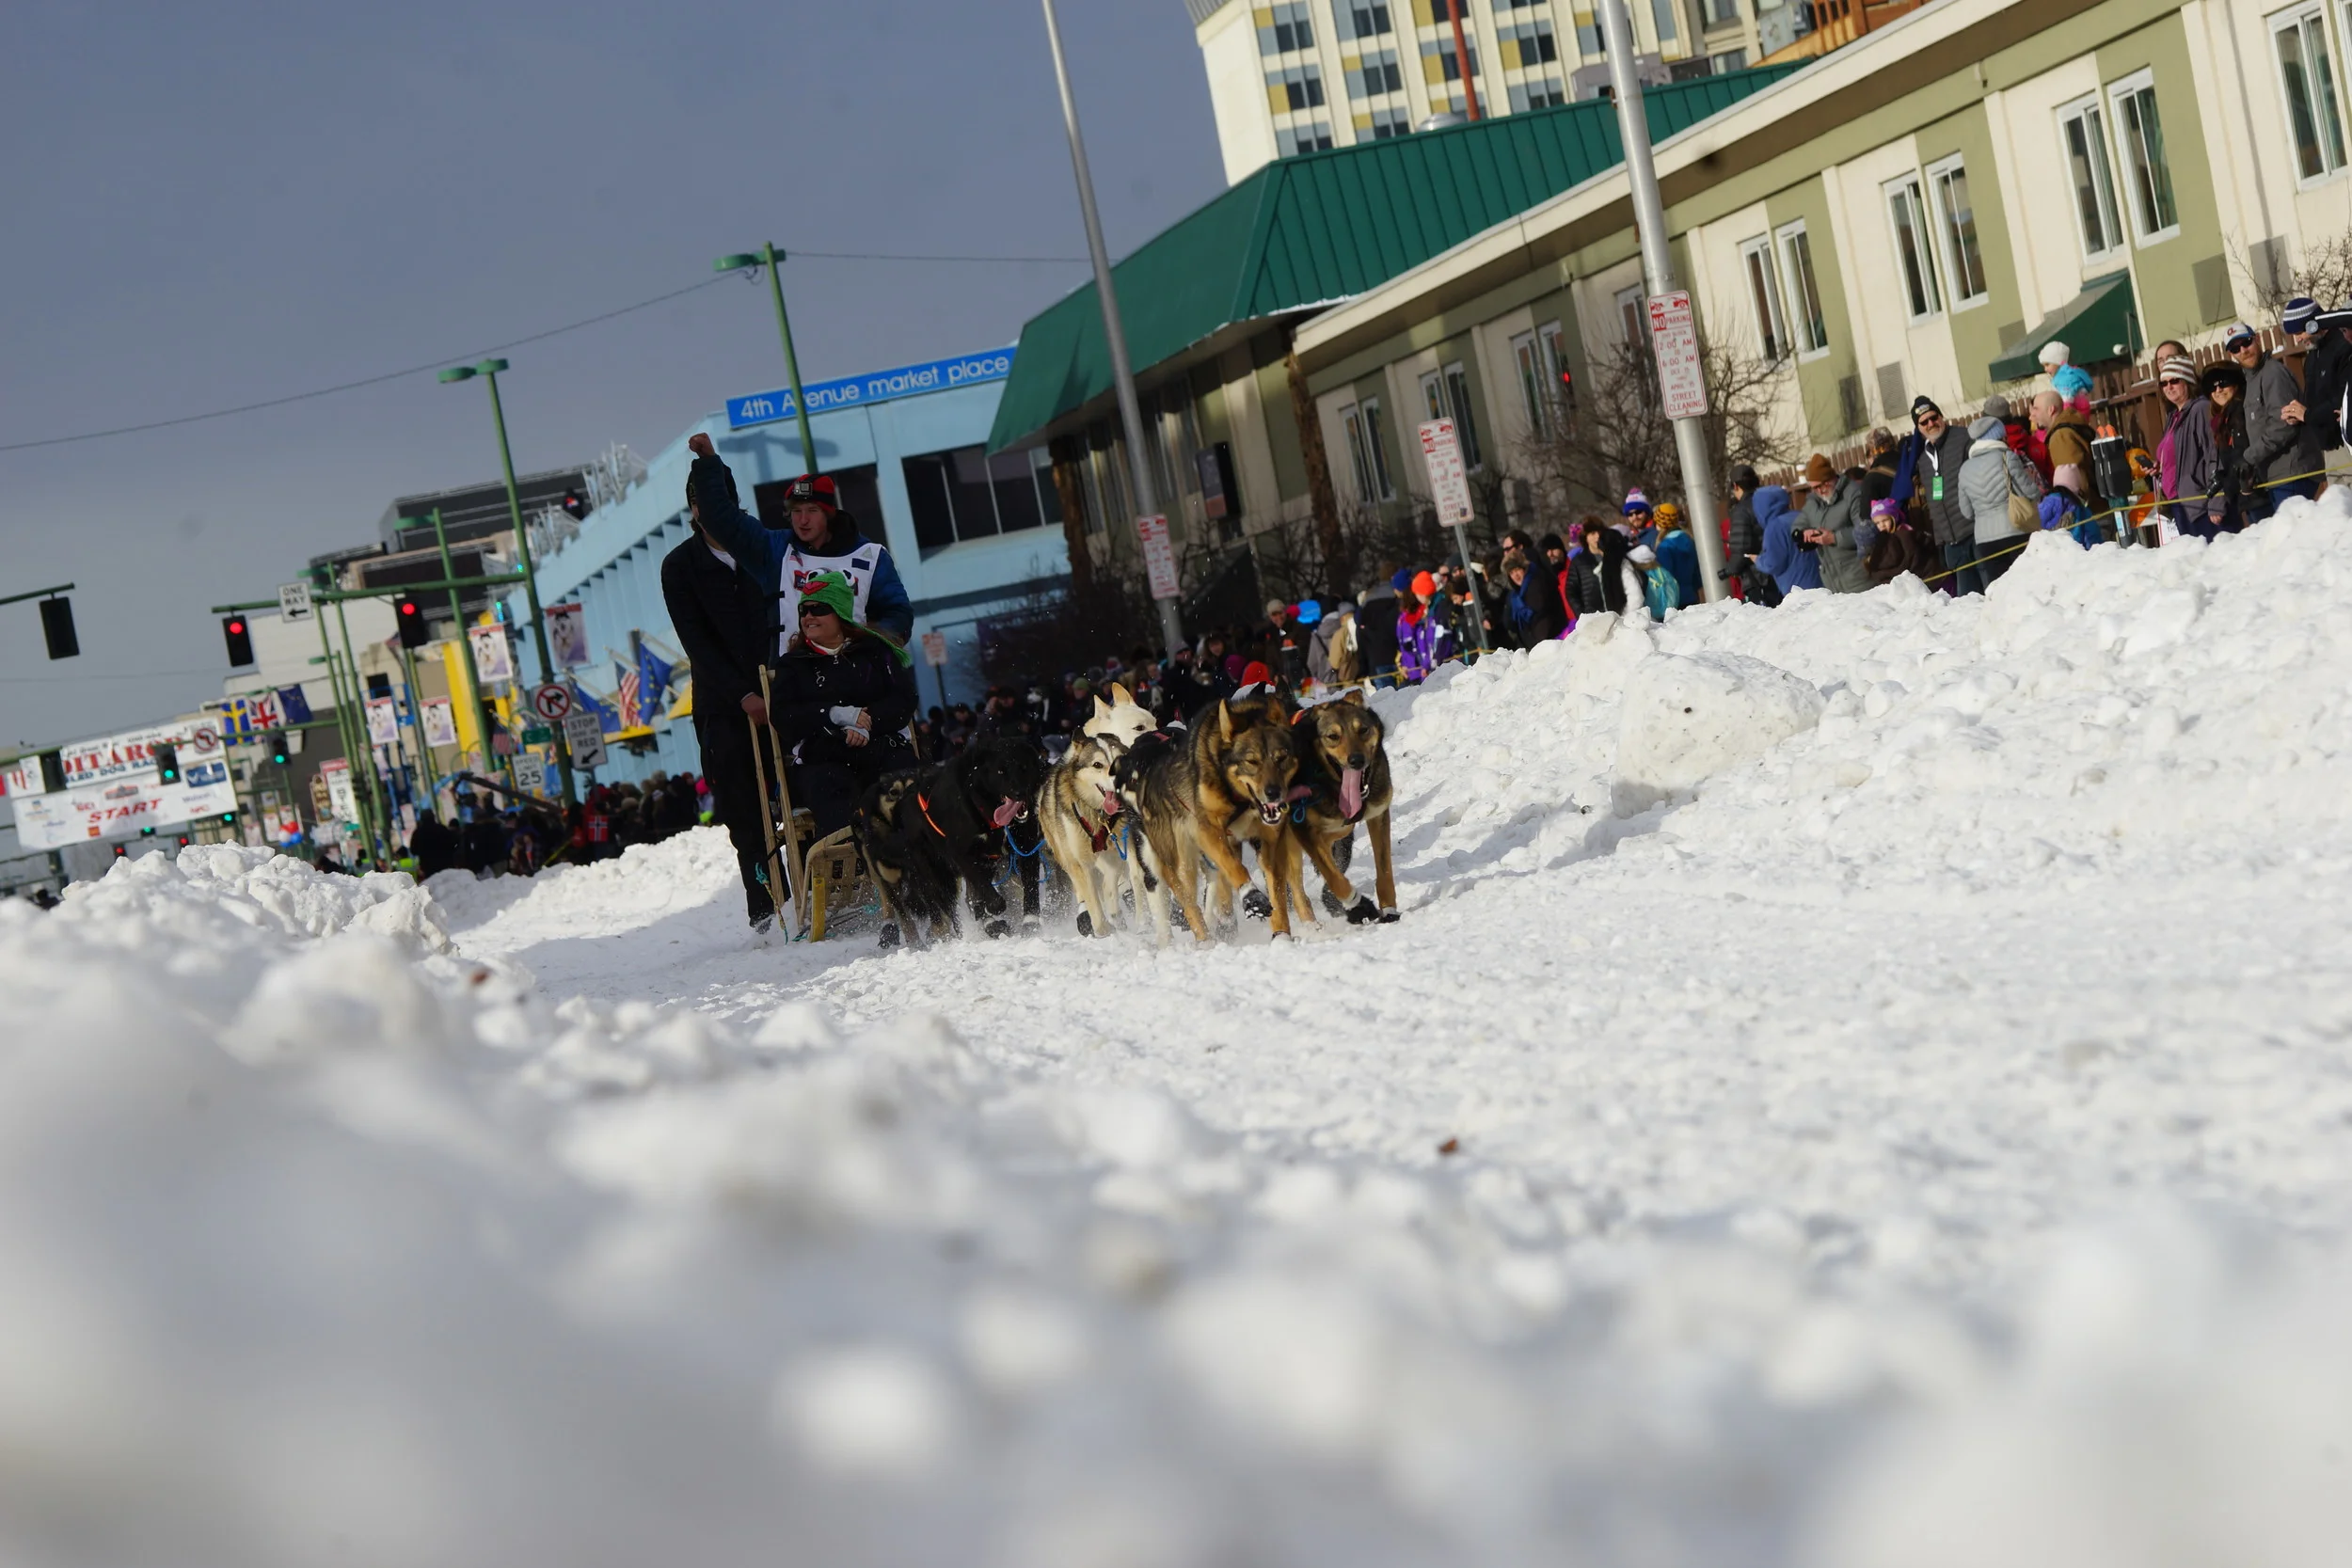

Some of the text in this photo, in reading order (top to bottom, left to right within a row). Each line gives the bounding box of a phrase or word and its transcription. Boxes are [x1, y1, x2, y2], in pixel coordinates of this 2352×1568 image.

[1653, 314, 1692, 330] NO PARKING
[740, 356, 1009, 420] 4th Aenue market place
[1671, 390, 1696, 403] STREET
[1668, 399, 1703, 412] CLEANING
[282, 585, 304, 597] ONE
[284, 594, 307, 607] WAY
[569, 716, 596, 731] STOP
[577, 736, 597, 749] RED
[100, 764, 126, 777] DOG
[132, 758, 157, 769] RAC
[518, 770, 542, 787] 25
[87, 798, 163, 824] START
